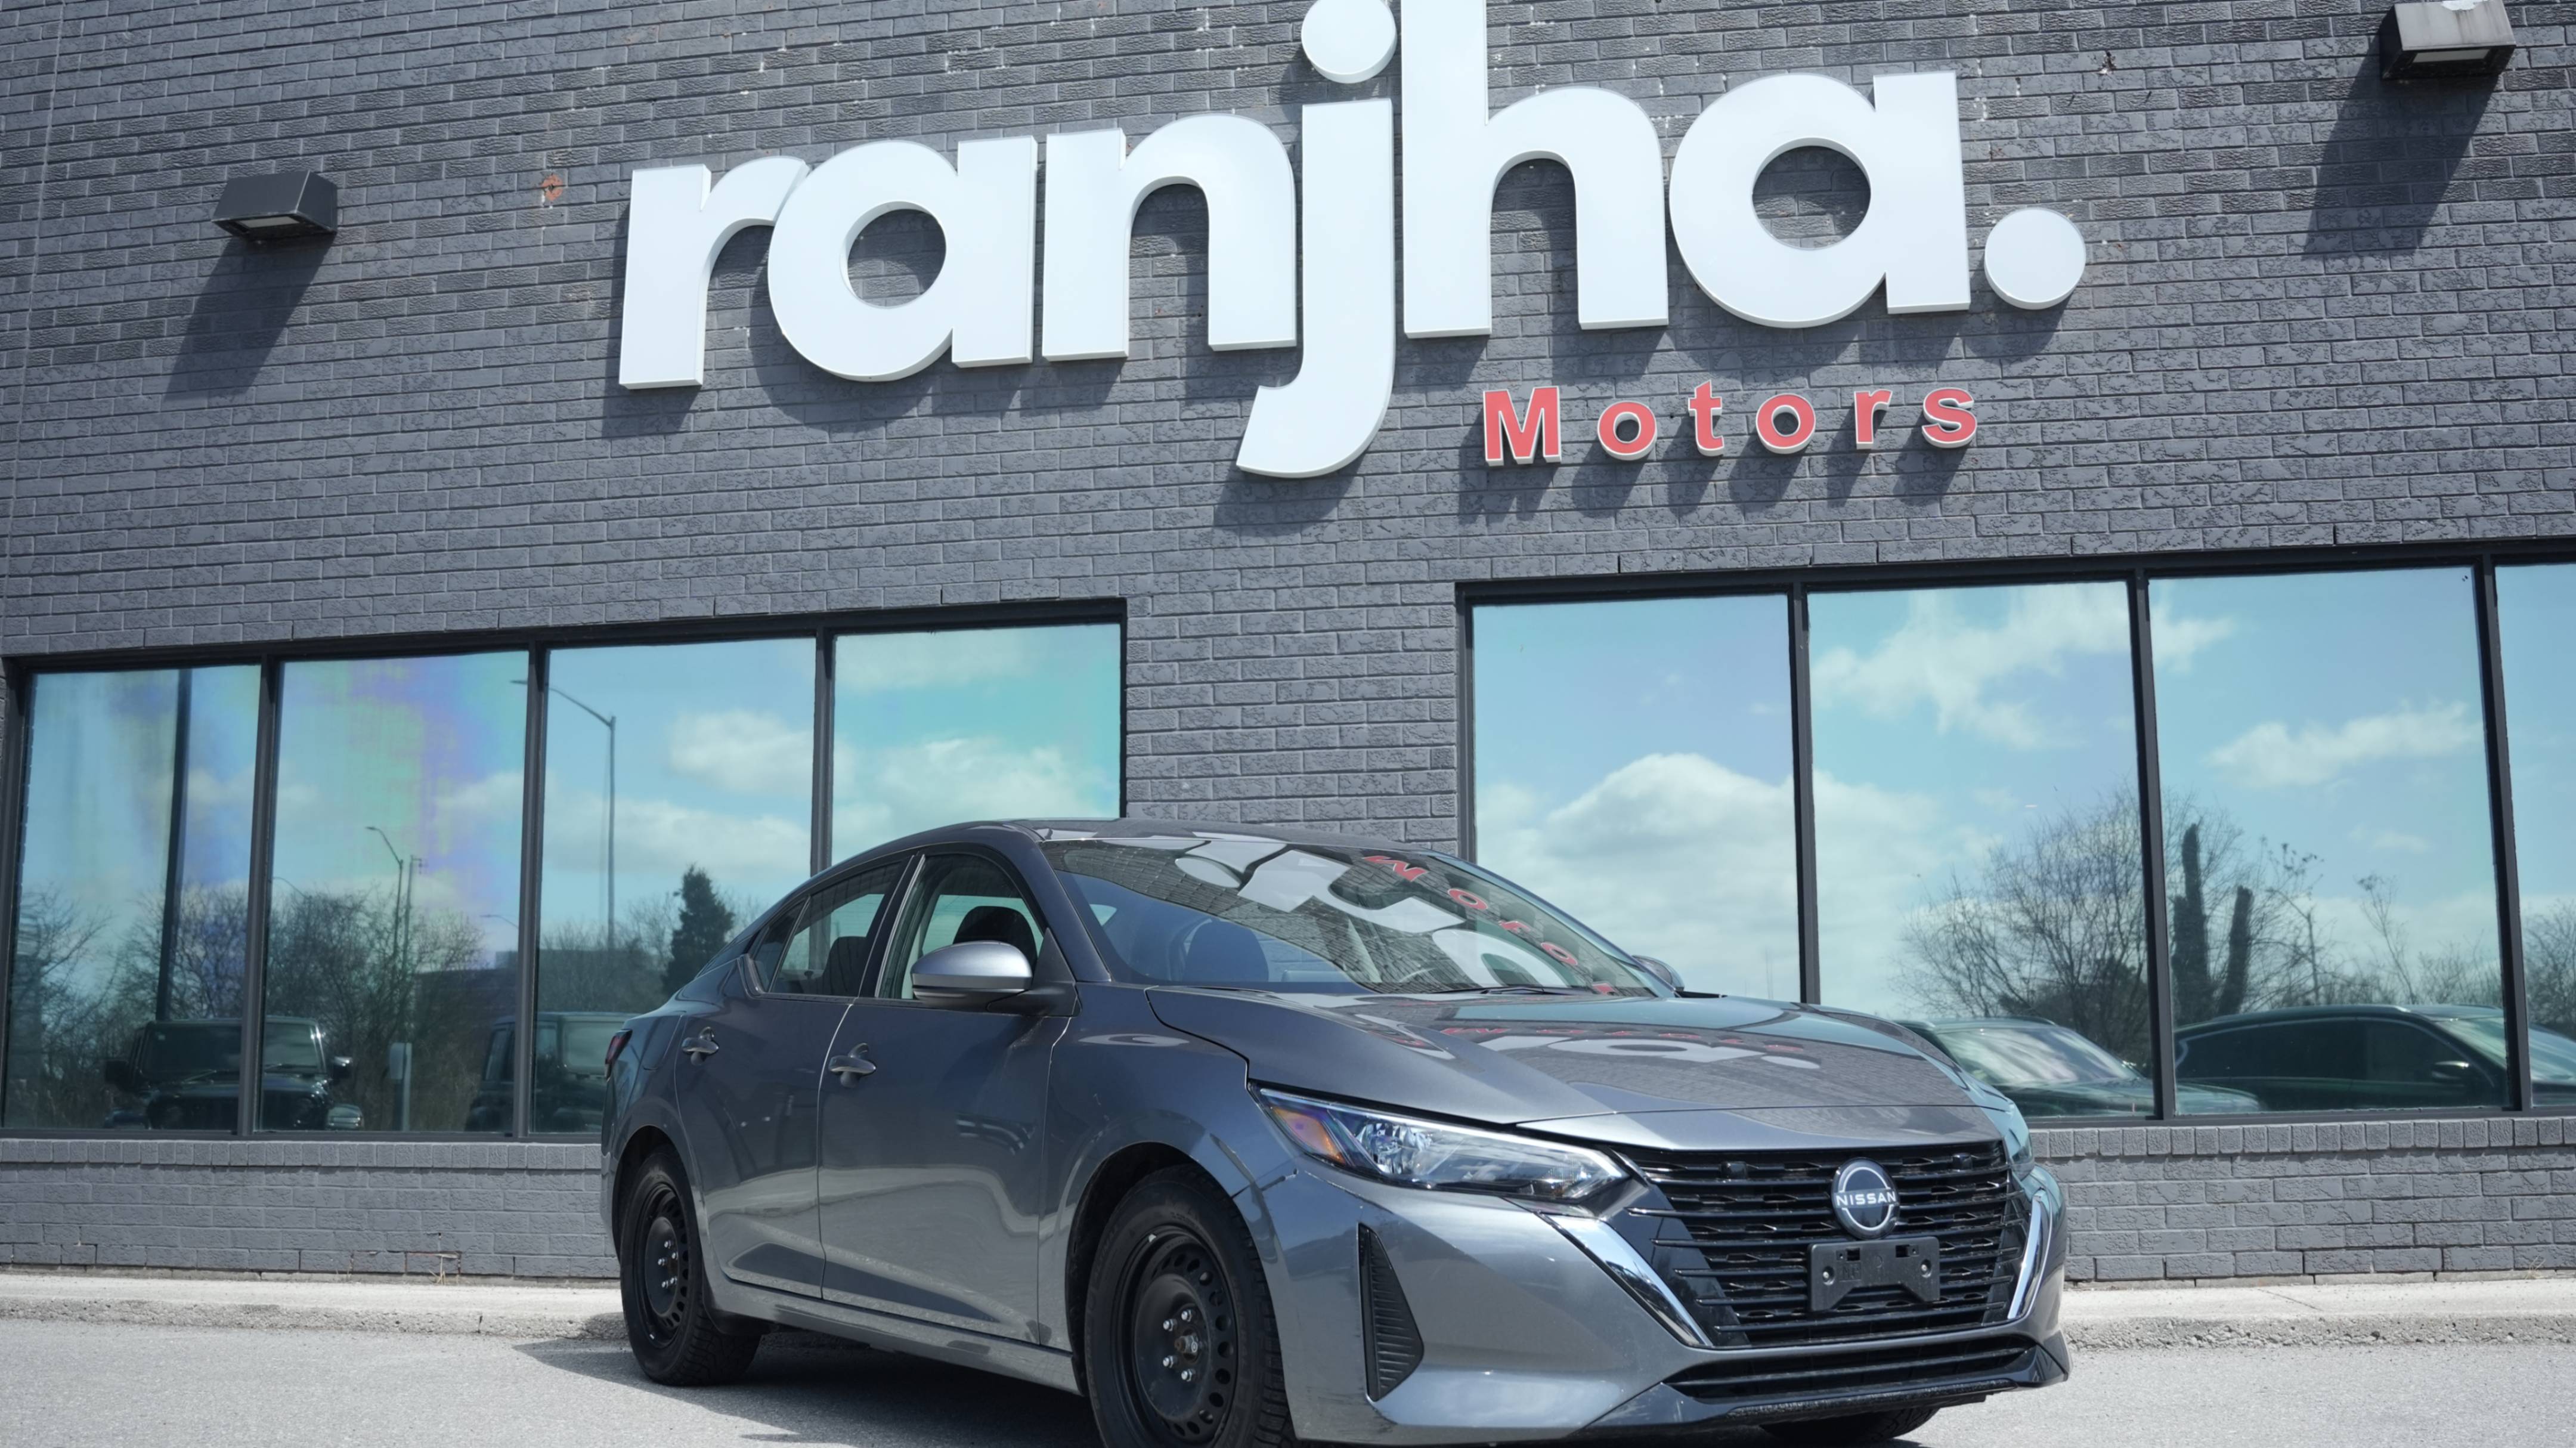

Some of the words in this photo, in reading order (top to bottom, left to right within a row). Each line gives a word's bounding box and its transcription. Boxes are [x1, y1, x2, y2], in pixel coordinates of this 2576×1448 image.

[619, 0, 2086, 478] ranjha.
[1482, 380, 1979, 467] Motors
[1837, 1192, 1896, 1206] NISSAN
